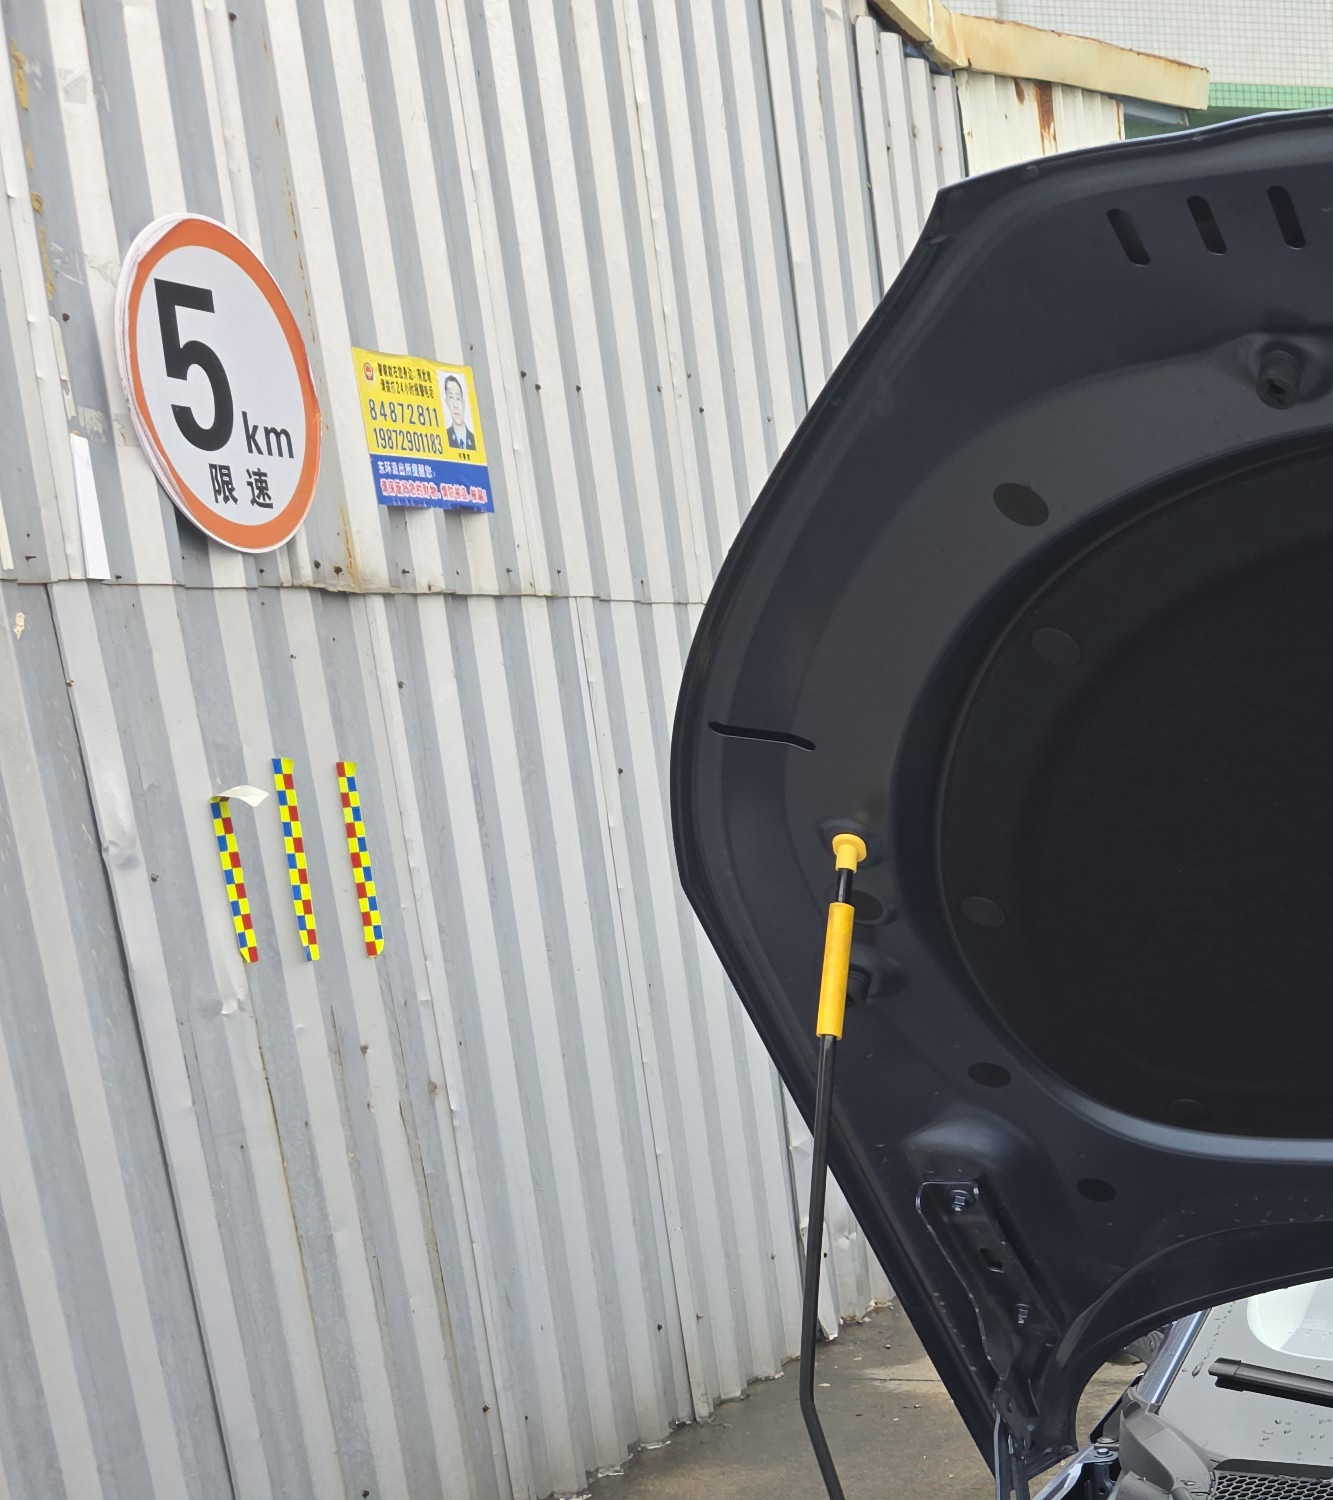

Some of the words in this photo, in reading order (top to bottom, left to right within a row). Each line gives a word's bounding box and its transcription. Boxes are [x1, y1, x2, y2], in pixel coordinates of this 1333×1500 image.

[154, 278, 234, 452] 5
[241, 411, 295, 459] km
[368, 398, 440, 428] 84872811
[373, 428, 444, 454] 19872901183
[208, 463, 274, 510] 限速
